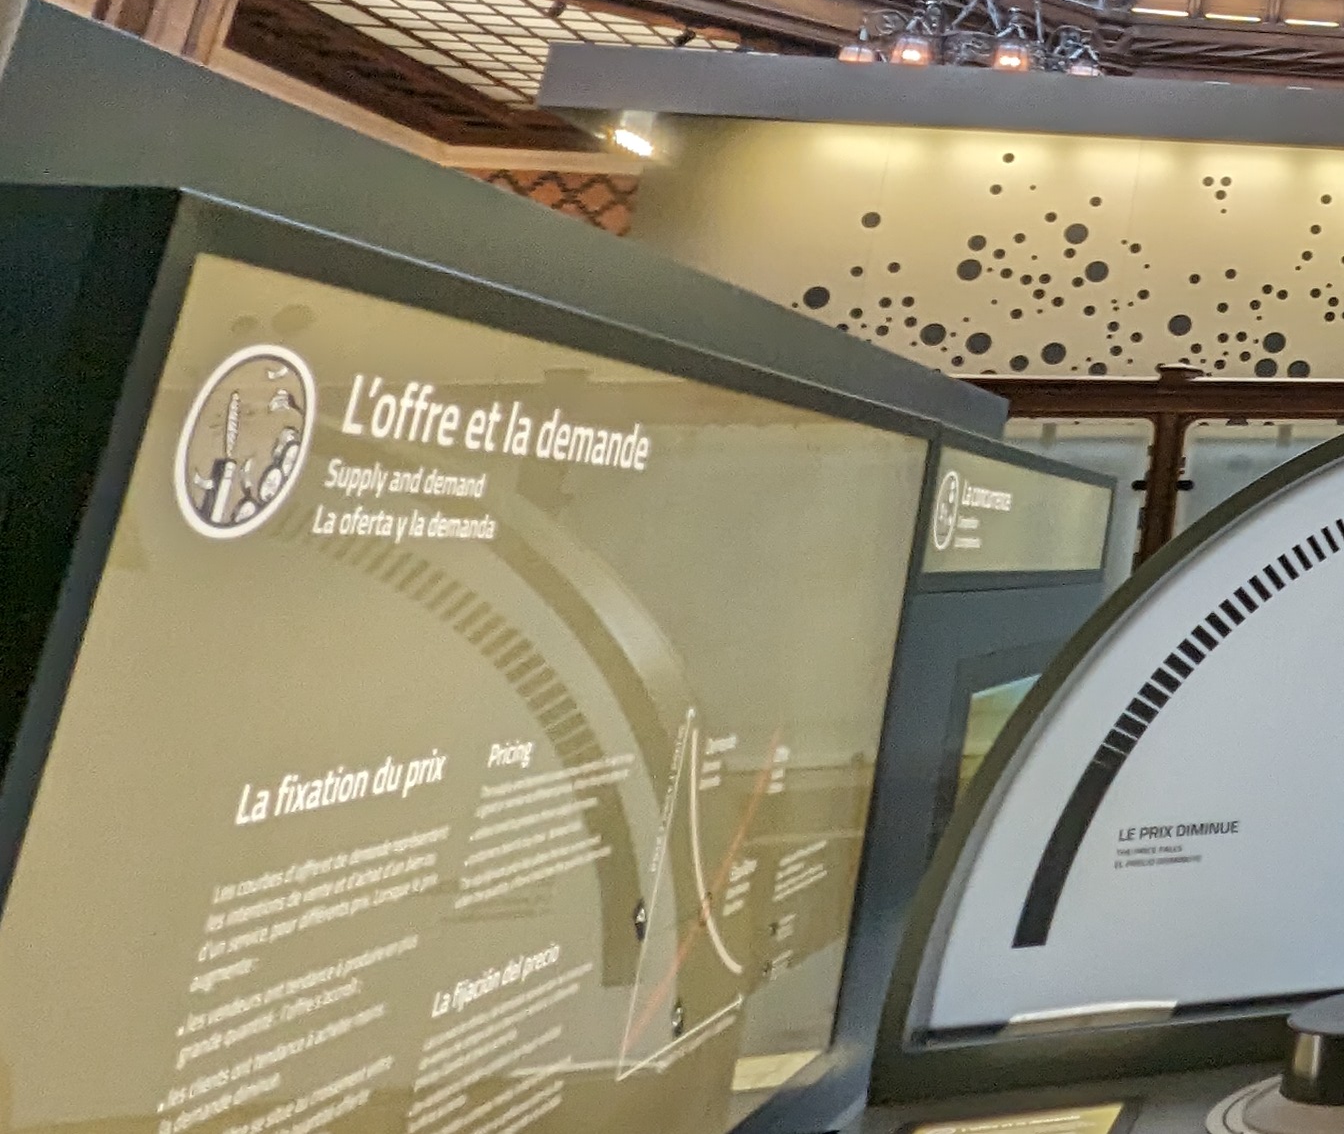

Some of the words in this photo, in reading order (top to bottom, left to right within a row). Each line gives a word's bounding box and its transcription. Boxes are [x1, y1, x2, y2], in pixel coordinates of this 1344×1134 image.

[342, 374, 460, 448] L'offre
[465, 401, 502, 454] et
[503, 400, 532, 456] la
[536, 408, 650, 471] demande
[324, 458, 389, 498] Supply
[388, 466, 423, 494] and
[422, 468, 487, 498] demand
[311, 504, 336, 535] La
[338, 506, 393, 537] oferta
[393, 515, 406, 545] y
[408, 508, 426, 538] la
[427, 511, 496, 541] demanda
[487, 739, 534, 768] Pricing
[235, 783, 270, 826] La
[274, 765, 370, 817] fixation
[371, 755, 403, 796] du
[401, 748, 448, 799] prix
[1118, 828, 1136, 842] LE
[1139, 826, 1174, 840] PRIX
[1176, 820, 1239, 837] DIMINUE
[431, 991, 451, 1018] La
[501, 954, 524, 986] del
[521, 942, 560, 983] precio
